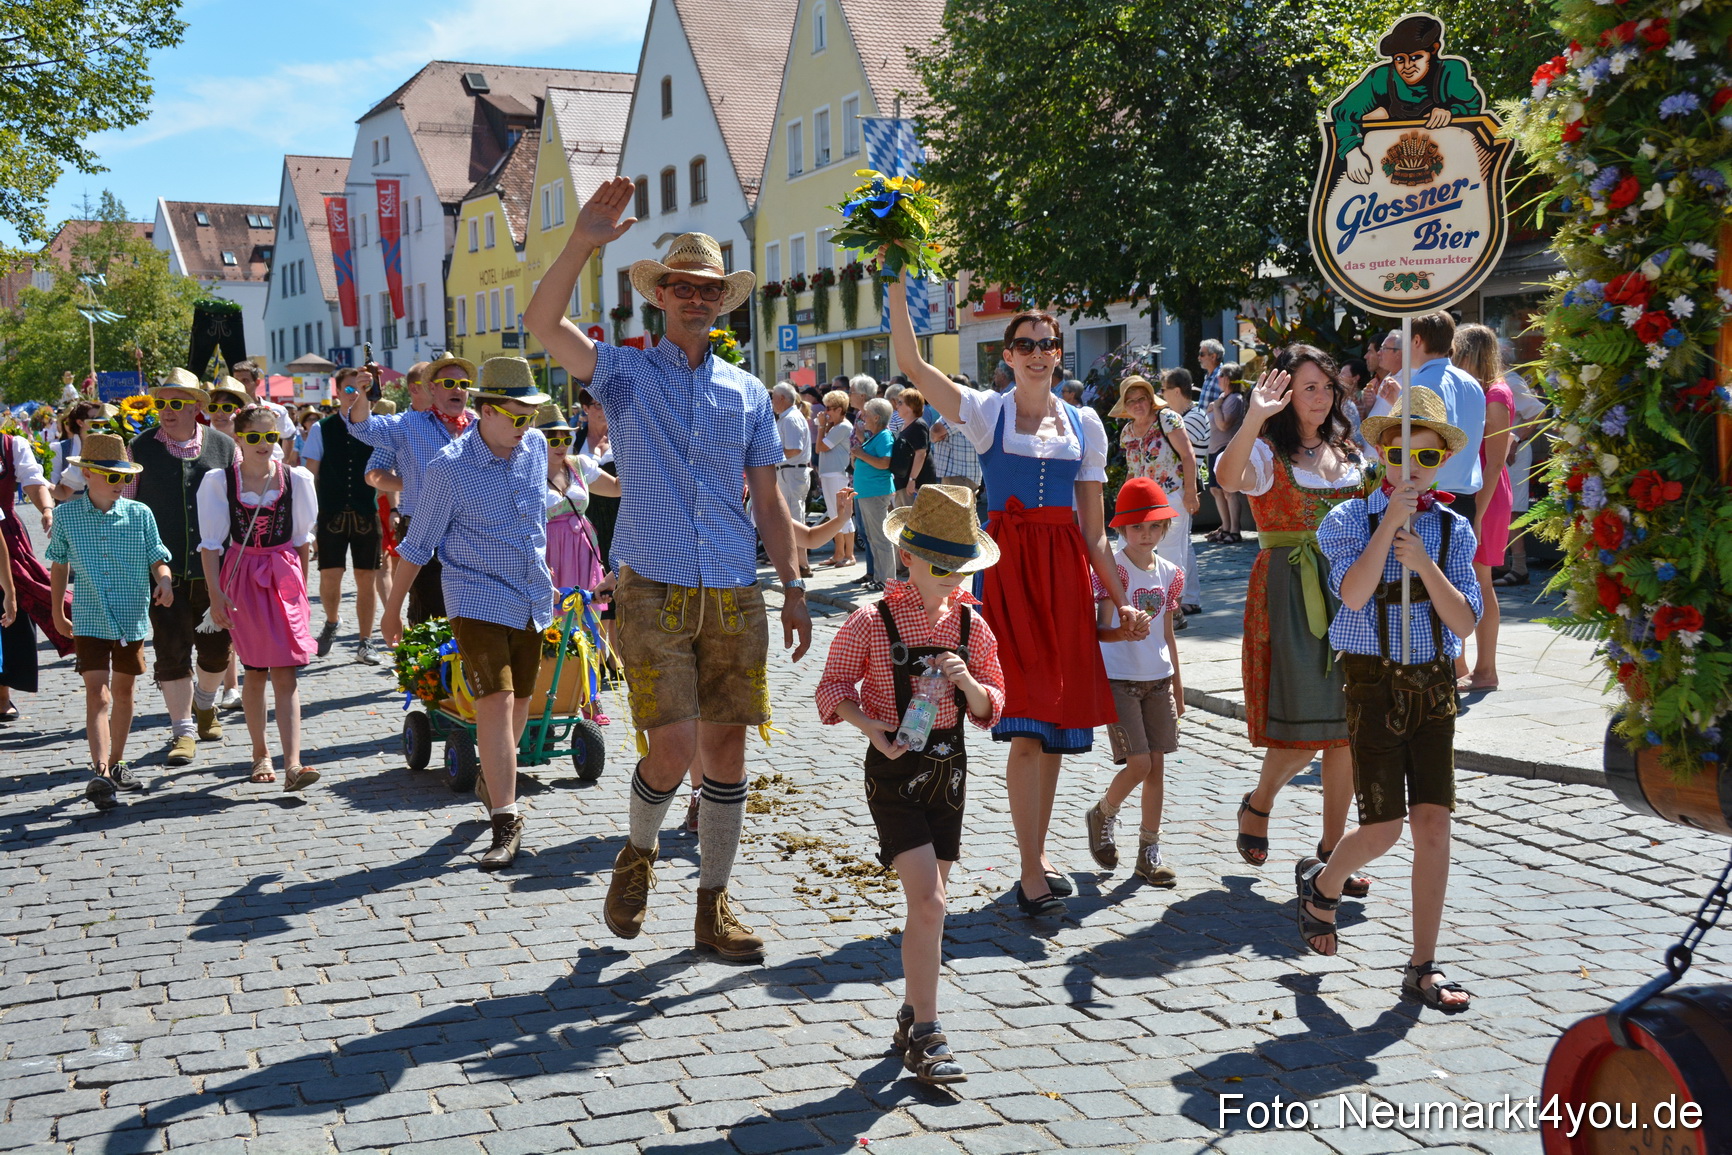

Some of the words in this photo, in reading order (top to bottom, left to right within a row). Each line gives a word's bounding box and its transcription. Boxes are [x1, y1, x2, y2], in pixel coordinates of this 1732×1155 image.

[380, 184, 393, 217] K&L
[1336, 177, 1480, 255] Glossner-
[1412, 218, 1480, 251] Bier
[479, 268, 498, 286] HOTEL
[1344, 260, 1367, 271] das
[1369, 258, 1397, 271] gute
[1399, 255, 1473, 267] Neumarkter
[947, 282, 955, 330] KINO
[782, 328, 794, 349] P
